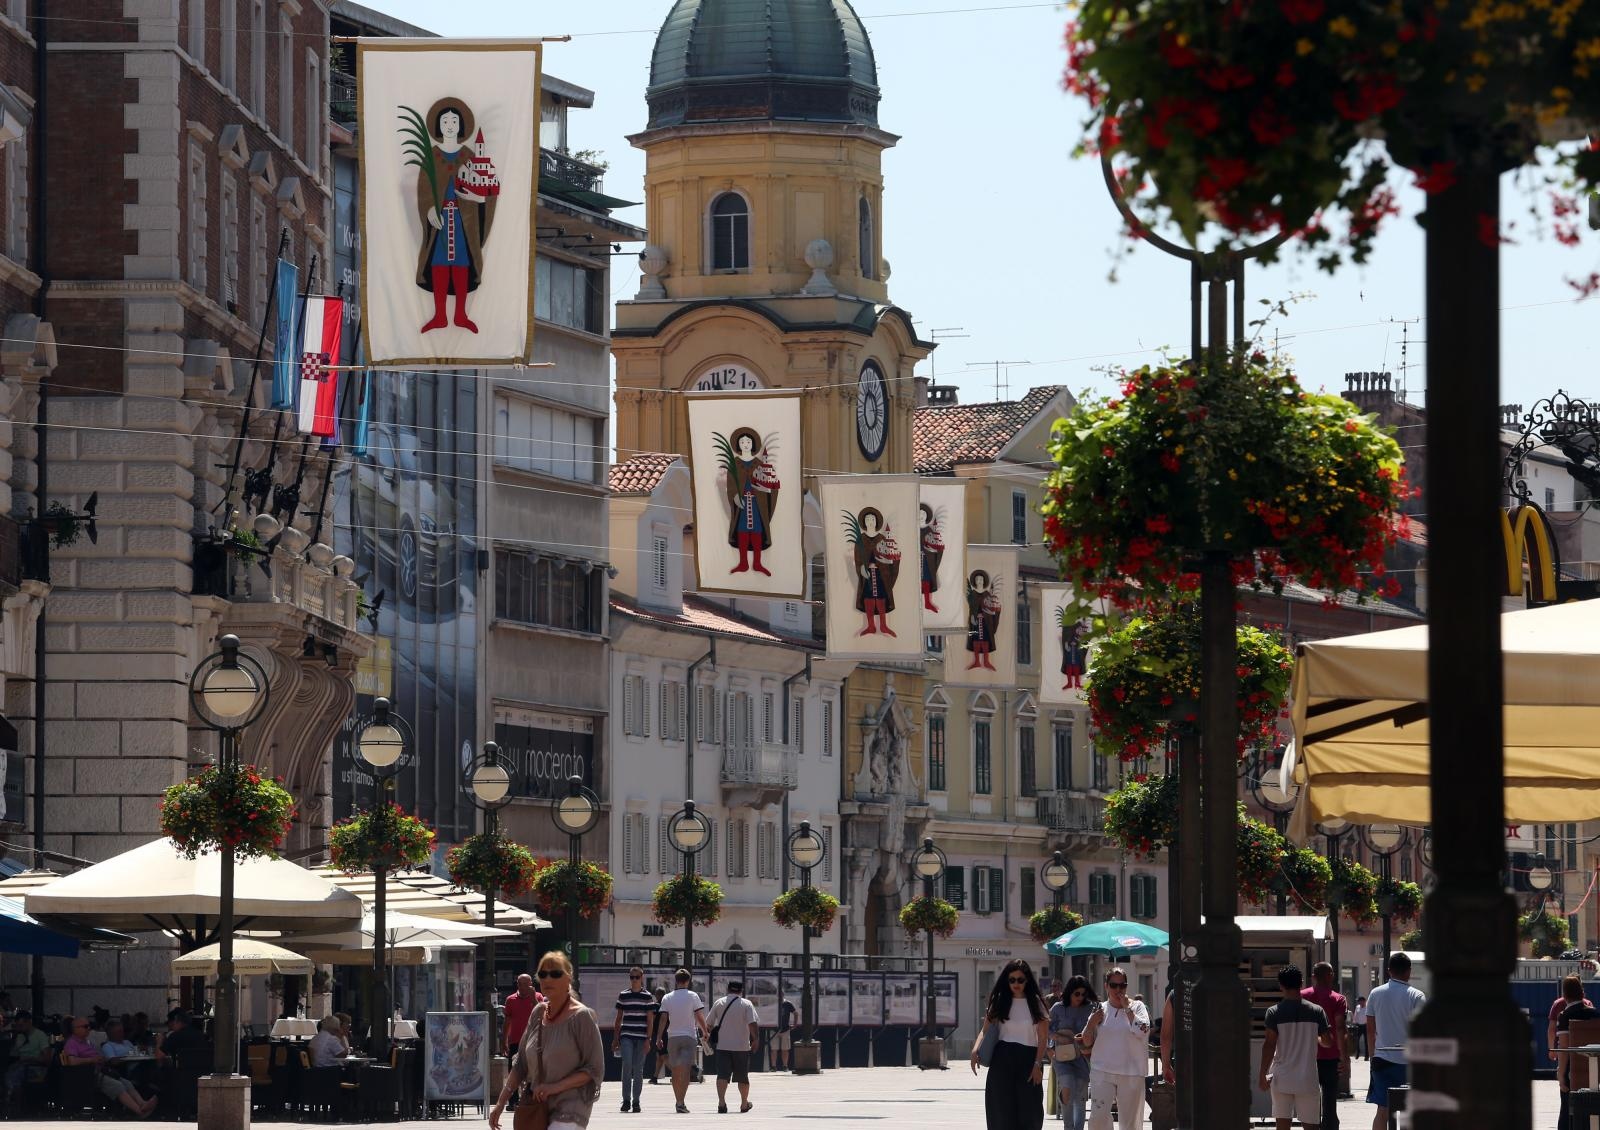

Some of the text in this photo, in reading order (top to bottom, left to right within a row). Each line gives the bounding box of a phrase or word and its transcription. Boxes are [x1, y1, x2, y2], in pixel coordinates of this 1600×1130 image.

[723, 368, 736, 385] 12
[740, 372, 746, 389] 1
[525, 743, 585, 781] moderato
[642, 924, 665, 937] ZARA
